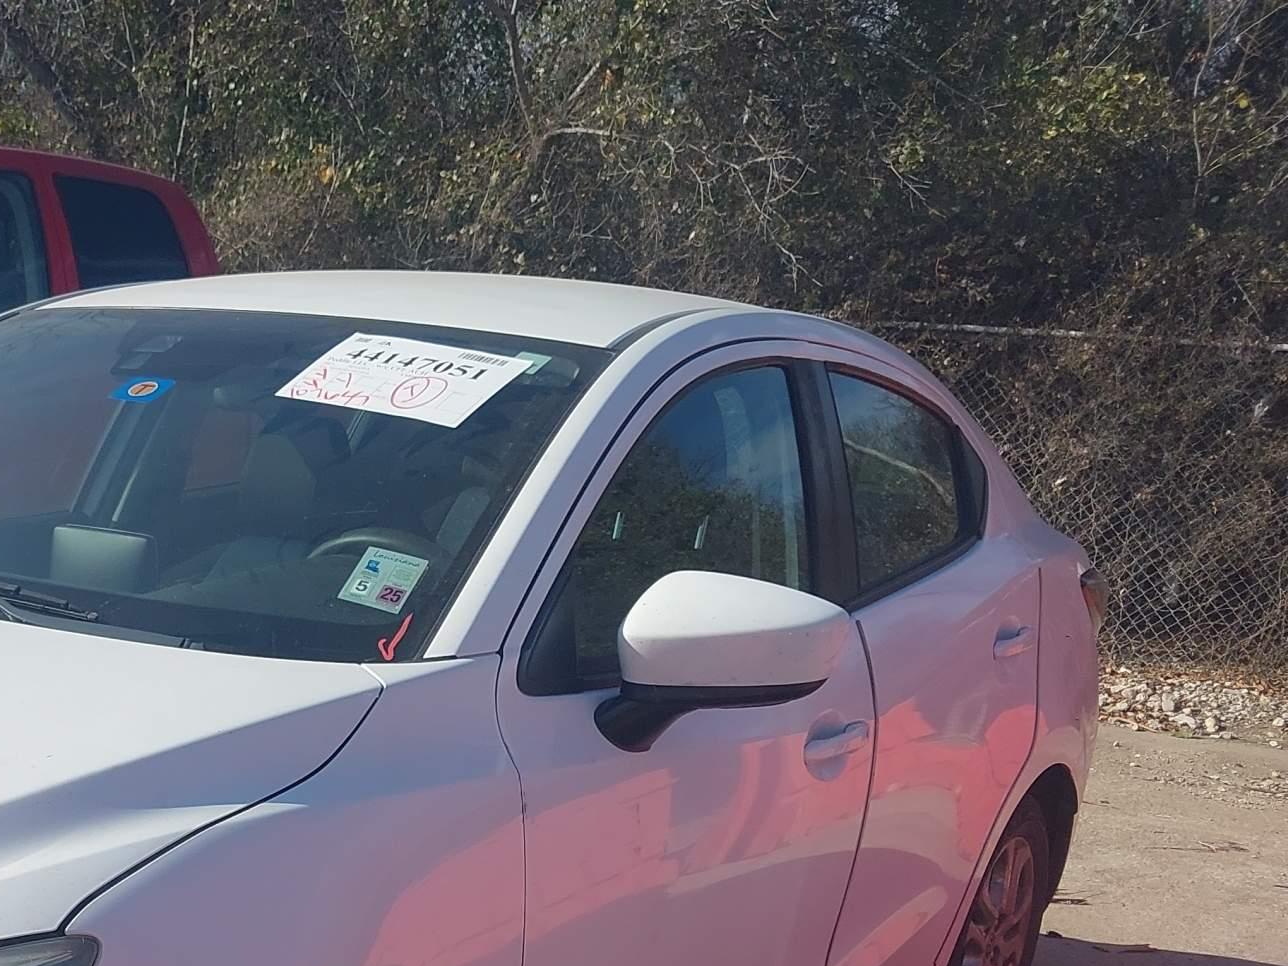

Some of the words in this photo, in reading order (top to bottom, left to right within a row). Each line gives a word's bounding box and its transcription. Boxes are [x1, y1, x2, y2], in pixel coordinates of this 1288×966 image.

[345, 348, 489, 381] 44147051
[355, 580, 370, 592] 5
[380, 587, 404, 603] 25
